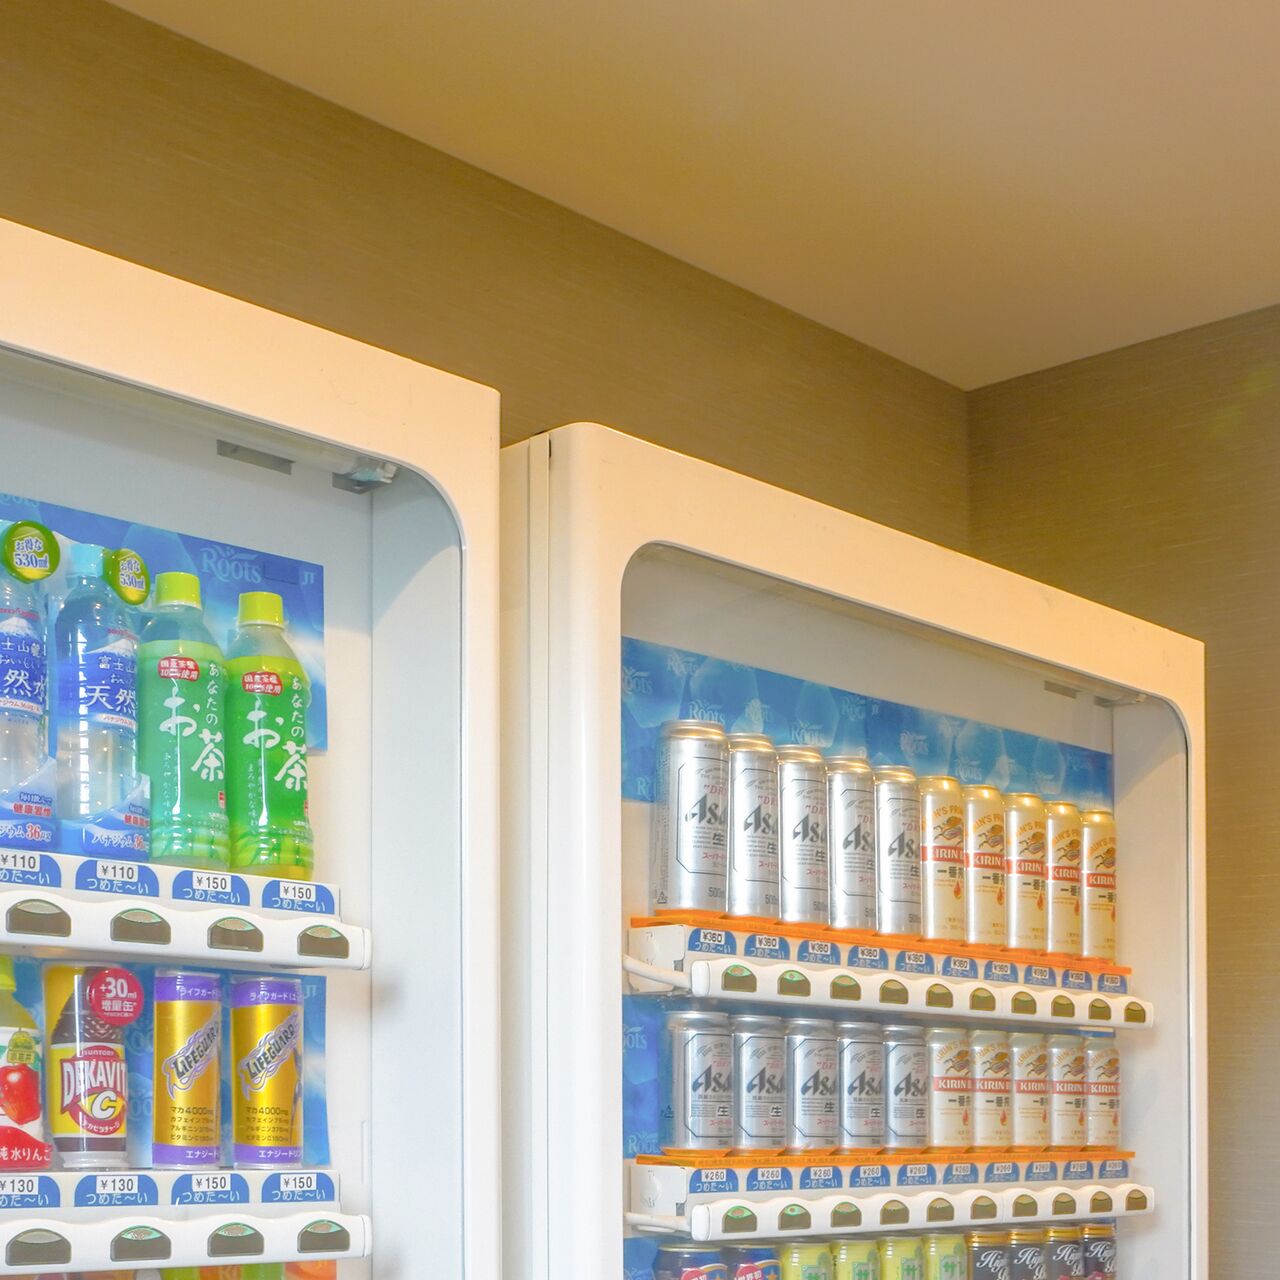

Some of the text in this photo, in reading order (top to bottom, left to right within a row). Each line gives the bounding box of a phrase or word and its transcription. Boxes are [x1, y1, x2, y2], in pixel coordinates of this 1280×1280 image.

[205, 663, 220, 725] あなたの
[291, 676, 305, 738] あなたの
[0, 853, 36, 870] ¥110
[973, 856, 1002, 866] KIRIN
[101, 864, 135, 880] ¥110
[1053, 867, 1079, 879] KIRIN
[196, 875, 227, 891] ¥150
[283, 885, 312, 900] ¥150
[938, 1078, 967, 1089] KIRIN
[976, 1081, 1005, 1090] KIRIN
[1020, 1081, 1046, 1091] KIRIN
[1056, 1083, 1082, 1092] KIRIN
[1090, 1084, 1117, 1094] KIRIN
